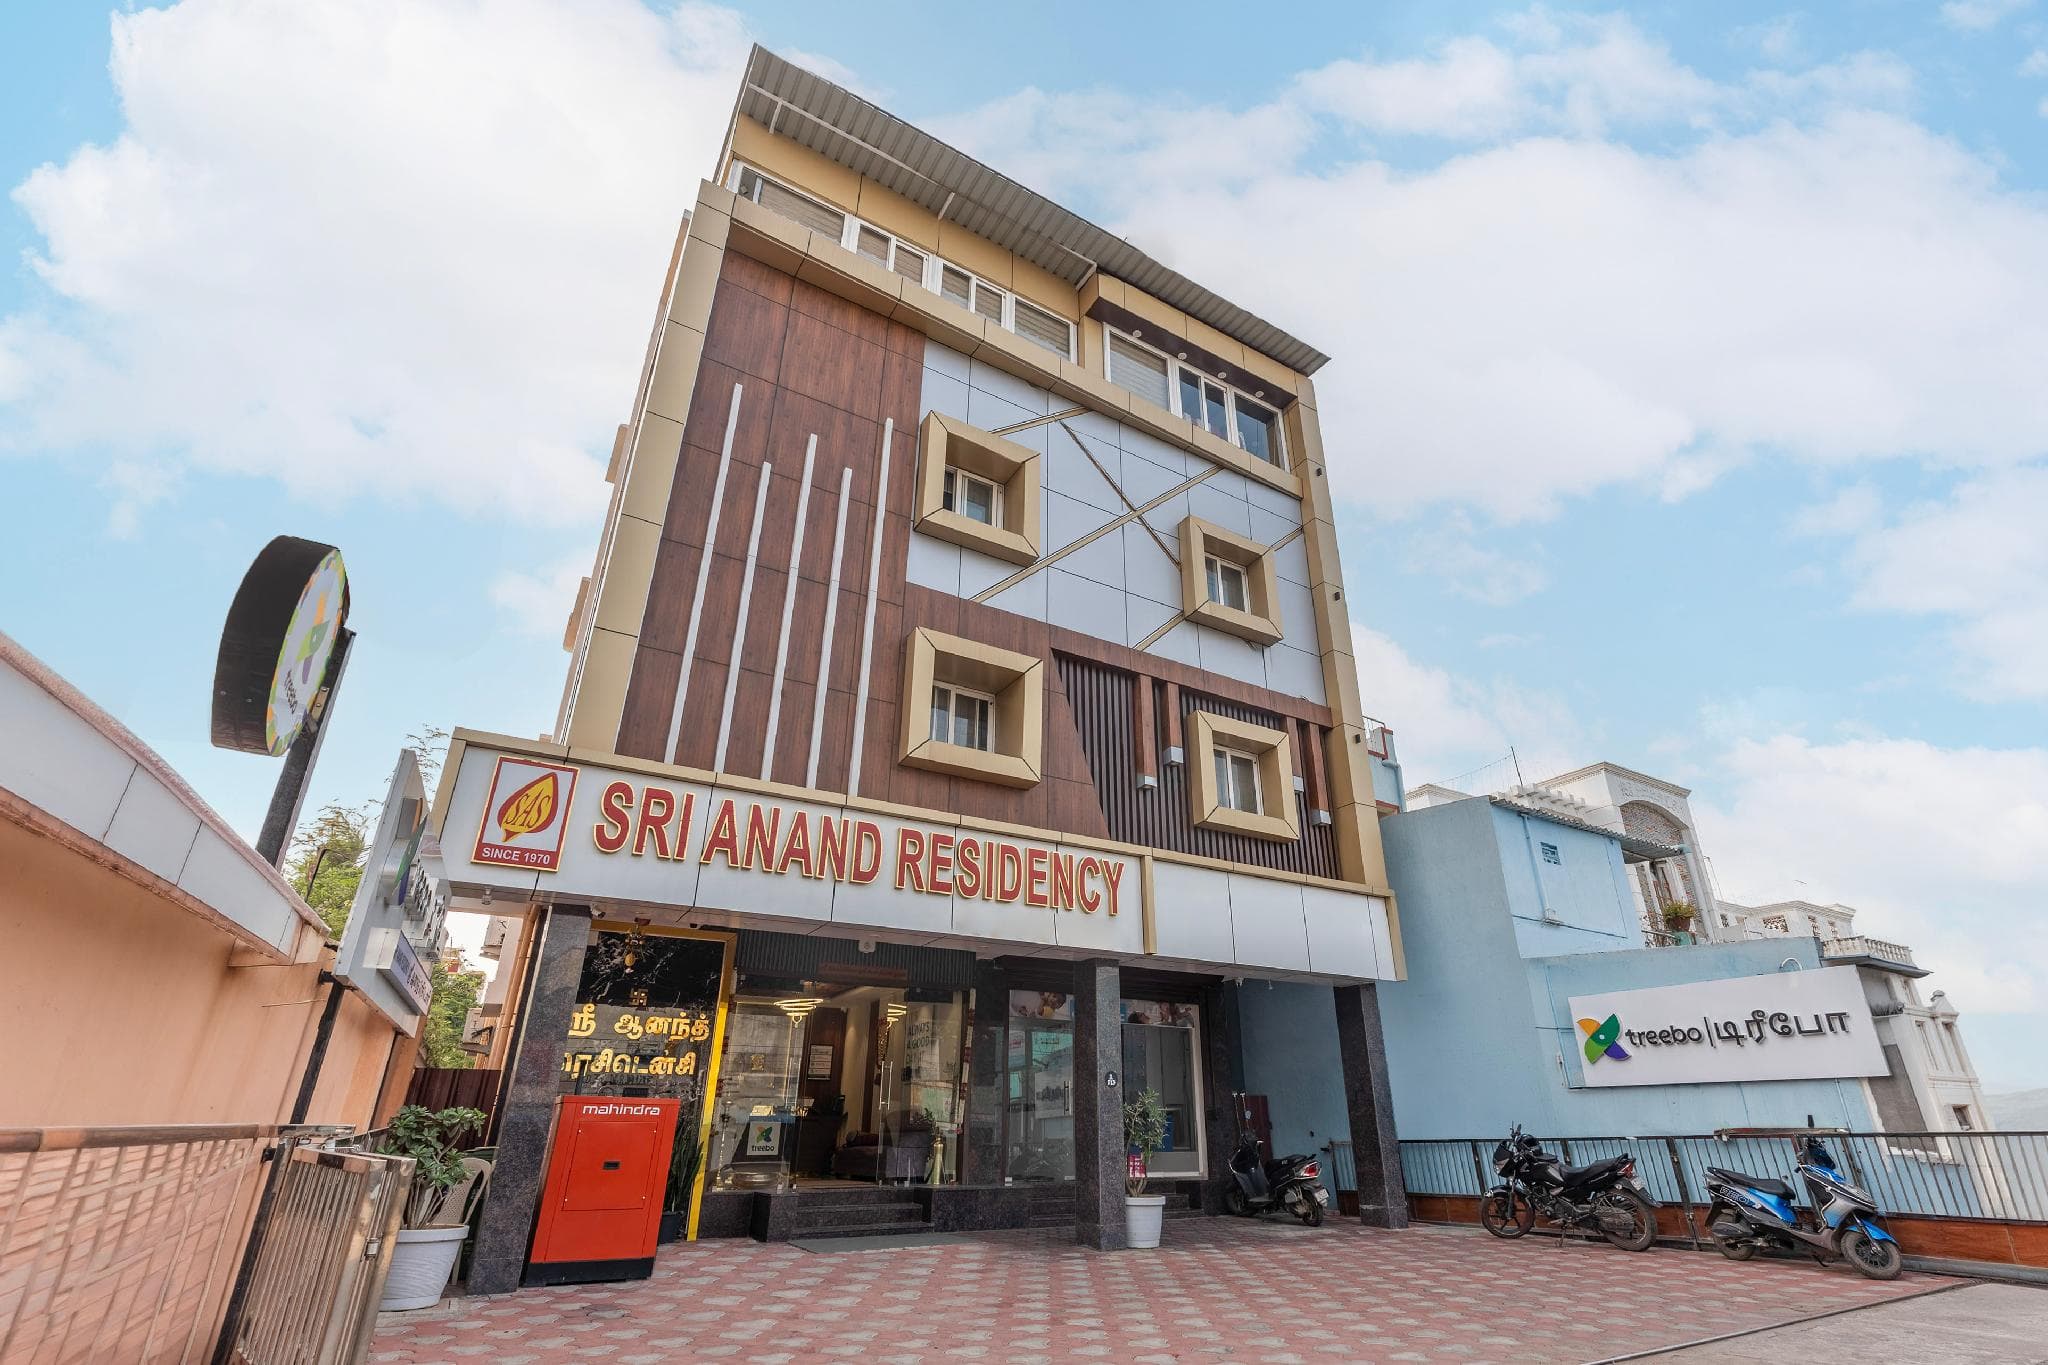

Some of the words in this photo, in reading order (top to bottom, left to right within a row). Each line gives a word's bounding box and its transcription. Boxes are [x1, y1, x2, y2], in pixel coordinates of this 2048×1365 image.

[505, 787, 551, 829] SAS
[481, 847, 521, 862] SINCE
[523, 851, 551, 865] 1970
[593, 780, 696, 862] SRI
[700, 798, 883, 885] ANAND
[895, 826, 1125, 916] RESIDENCY
[613, 1010, 710, 1043] ஆனந்த்
[1625, 1024, 1702, 1047] treebo
[1713, 1009, 1850, 1047] டிரீபோ
[582, 1103, 661, 1116] mahindra
[751, 1144, 775, 1152] treebo
